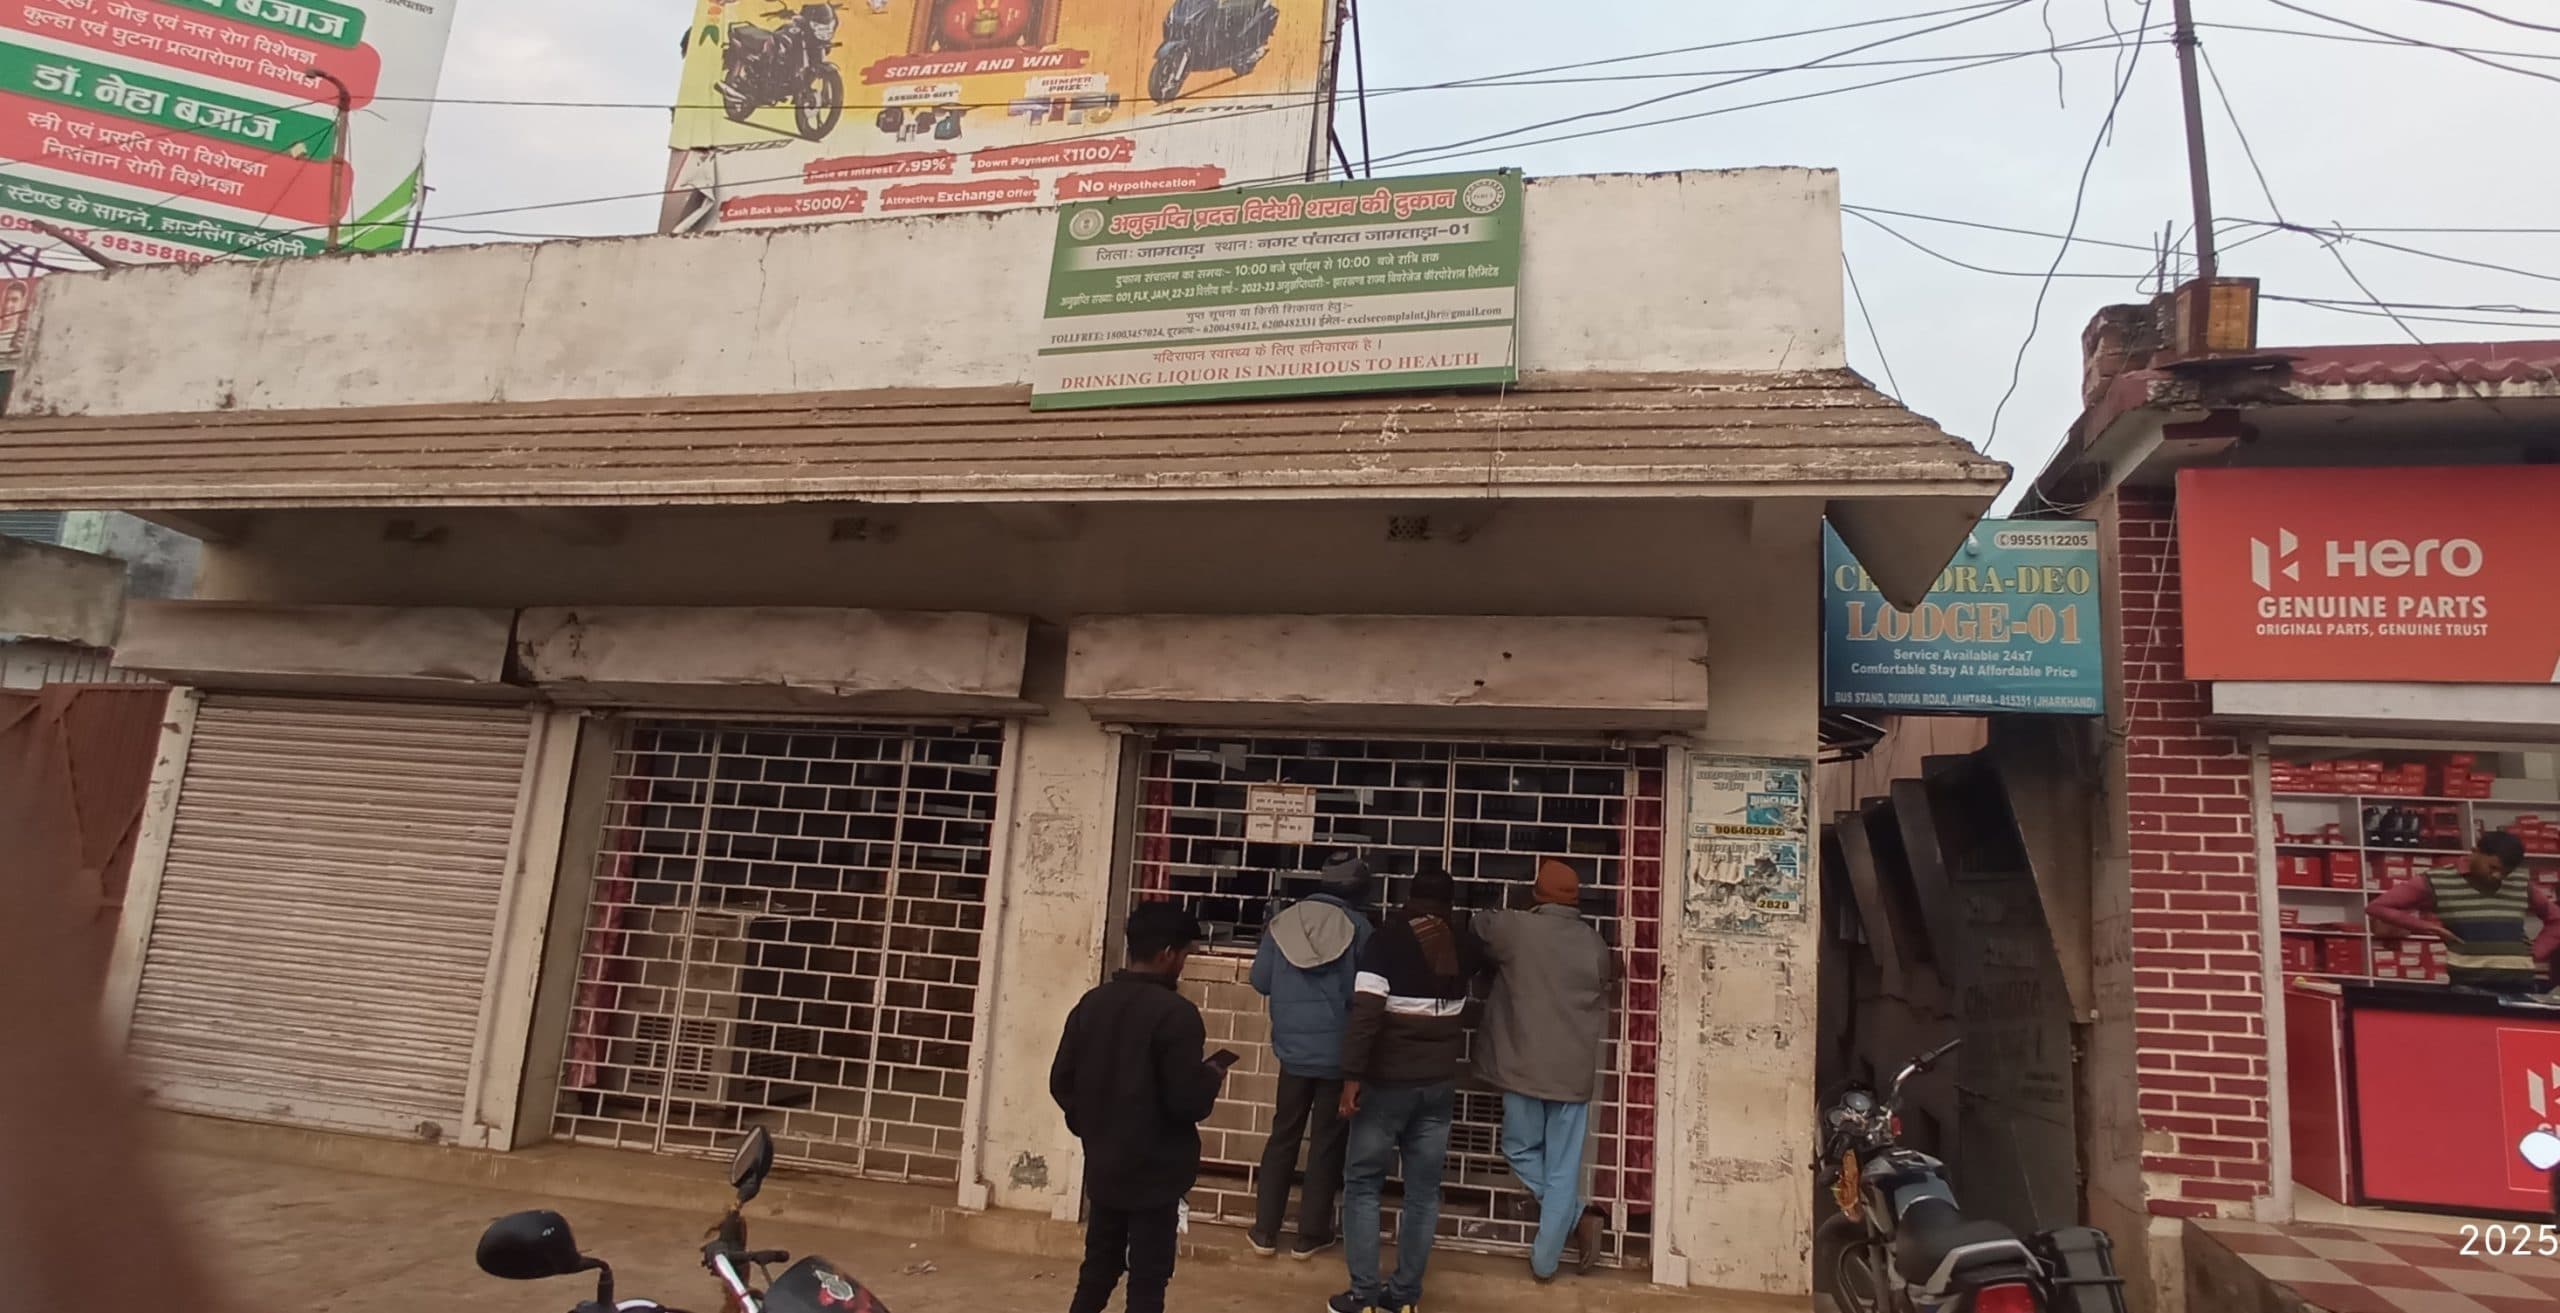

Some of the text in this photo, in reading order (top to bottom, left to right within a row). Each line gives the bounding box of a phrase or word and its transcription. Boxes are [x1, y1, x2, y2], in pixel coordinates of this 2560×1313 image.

[235, 0, 350, 39] बजाज
[23, 5, 76, 29] कुल्हा
[80, 19, 109, 37] एवं
[112, 26, 164, 51] घुटना
[166, 39, 254, 73] प्रत्यारोपण
[107, 2, 149, 27] जोड़
[153, 12, 178, 30] एवं
[182, 20, 216, 40] नस
[219, 26, 251, 49] रोग
[254, 34, 318, 65] विशेषज्ञ
[885, 54, 1064, 79] SCRATCH AND WIN
[32, 63, 281, 141] डॉ. नेहा बजाज
[27, 111, 269, 178] स्त्री एवं प्रसूति रोग विशेषज्ञा
[850, 166, 893, 177] Interest
[977, 158, 1008, 168] Down
[1011, 154, 1060, 167] Payment
[125, 156, 167, 180] रोगी
[170, 167, 245, 197] विशेषज्ञा
[1078, 177, 1197, 193] No Hypothecation
[886, 190, 1033, 205] Attractive Exchange Offer
[8, 184, 307, 256] स्टैण्ड के सामने, हाउसिंग कॉलोनी
[727, 208, 749, 217] Cash
[750, 206, 772, 215] Back
[1109, 204, 1191, 240] अनुज्ञप्ति
[1194, 206, 1240, 231] प्रदत्त
[1243, 193, 1303, 223] विदेशी
[1305, 195, 1357, 218] शराब
[1360, 187, 1390, 215] की
[1394, 189, 1457, 220] दुकान
[1137, 243, 1205, 260] जामताड़ा
[1258, 234, 1298, 249] नगर
[1302, 231, 1360, 246] पंचायत
[1235, 263, 1267, 276] 10:00
[1324, 257, 1333, 270] से
[1337, 256, 1370, 269] 10:00
[1422, 253, 1440, 264] तक
[1240, 307, 1250, 317] या
[1254, 304, 1279, 316] किसी
[1283, 302, 1323, 315] शिकायत
[1210, 346, 1250, 360] स्वास्थ्य
[1255, 344, 1267, 356] के
[1271, 342, 1294, 356] लिए
[1300, 340, 1359, 355] हानिकारक
[1363, 337, 1373, 351] है
[1061, 352, 1480, 390] DRINKING LIQUOR IS INJURIOUS TO HEALTH
[2009, 534, 2089, 547] 9955112205
[2257, 596, 2488, 619] GENUINE PARTS
[1846, 601, 2081, 645] LODGE-01
[2256, 623, 2488, 638] ORIGINAL PARTS, GENUINE TRUST
[1893, 649, 2033, 662] Service Available 24x7
[1851, 663, 2077, 678] Comfortable Stay At Affordable Price
[1834, 691, 1853, 703] BUS
[1888, 693, 1920, 705] DUMKA
[1952, 695, 1993, 705] JAMTARA
